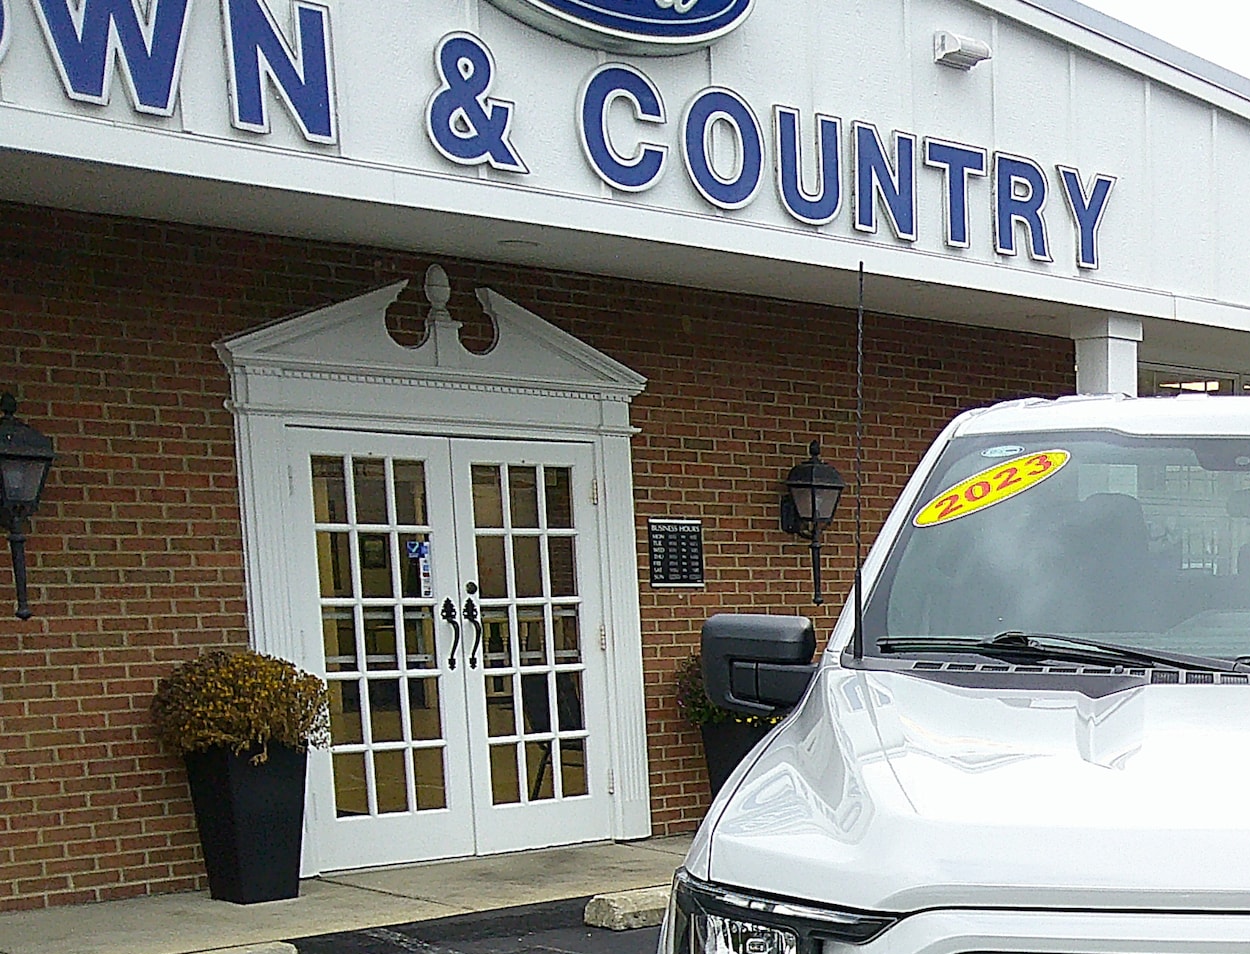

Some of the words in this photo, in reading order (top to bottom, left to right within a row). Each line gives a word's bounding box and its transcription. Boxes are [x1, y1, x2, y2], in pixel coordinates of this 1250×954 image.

[0, 0, 338, 146] WN
[427, 30, 530, 174] &
[576, 61, 1118, 270] COUNTRY
[935, 454, 1052, 520] 2023
[651, 524, 678, 533] BUSINESS
[679, 525, 700, 533] HOURS
